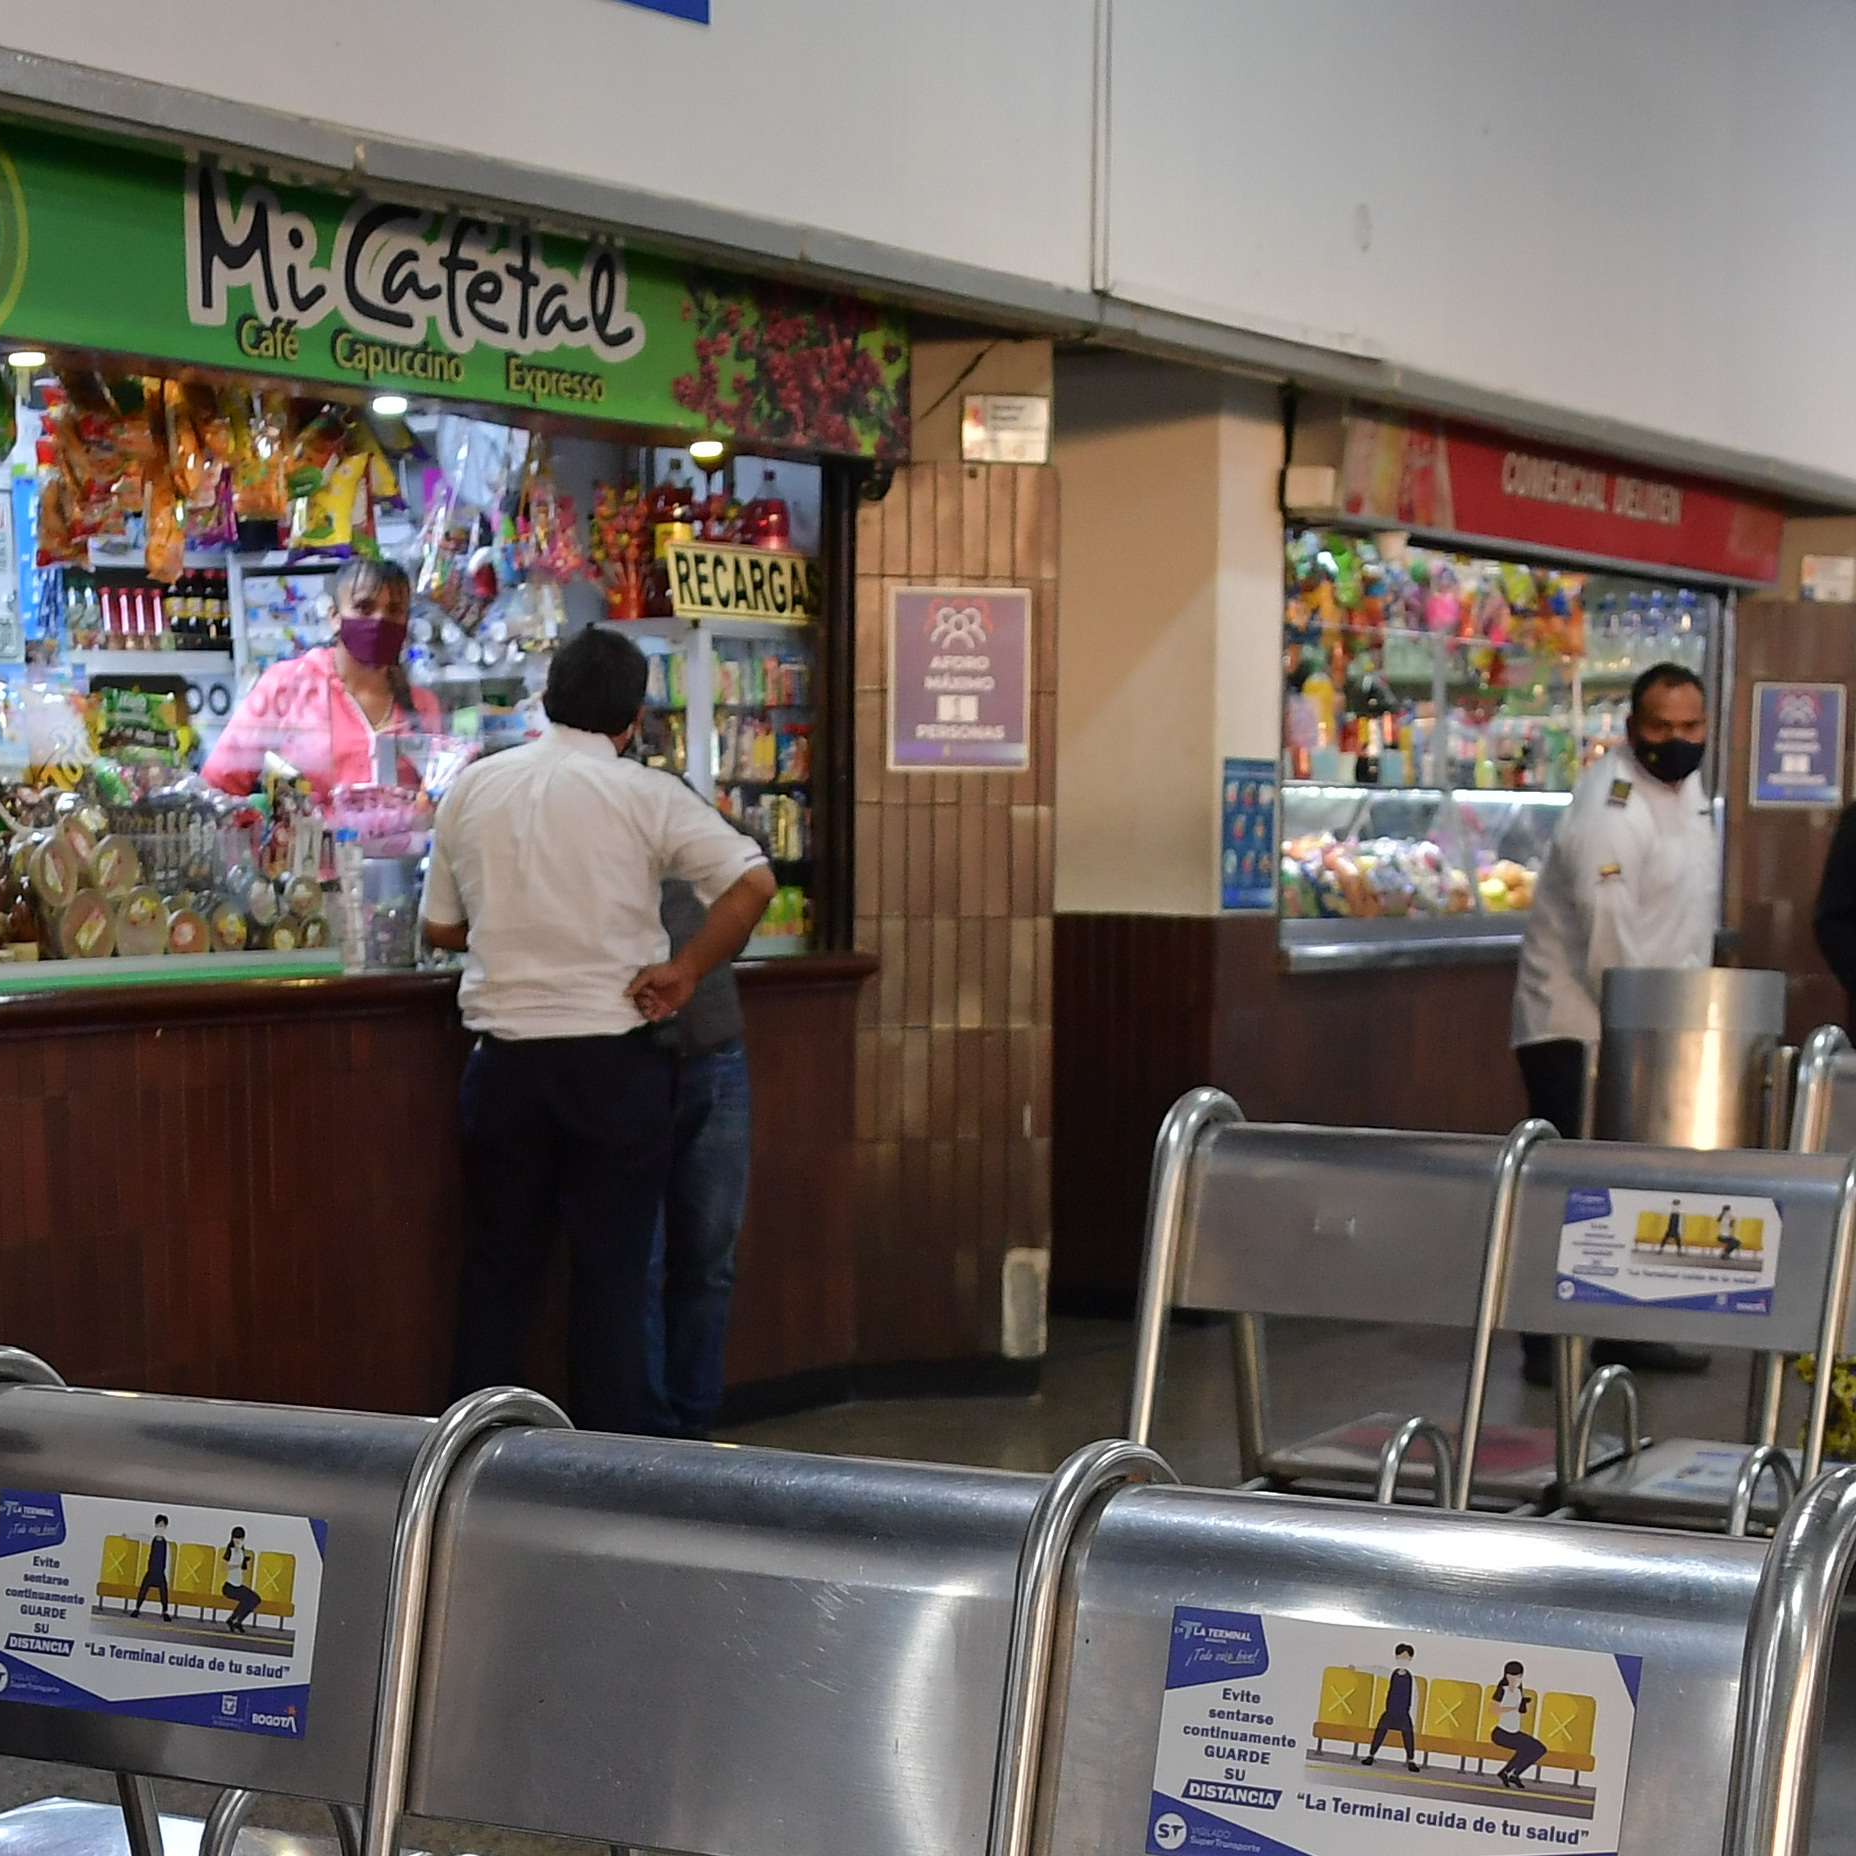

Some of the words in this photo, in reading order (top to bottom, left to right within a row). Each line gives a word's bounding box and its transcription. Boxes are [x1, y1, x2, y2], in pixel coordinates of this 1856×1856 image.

[195, 160, 328, 314] Mi
[342, 202, 636, 350] Cafetal
[238, 316, 300, 362] Café
[332, 326, 467, 384] Capuccino
[507, 354, 607, 403] Expresso
[32, 1555, 60, 1568] Evite
[23, 1573, 70, 1586] sentarse
[5, 1587, 85, 1606] continuamente
[20, 1603, 67, 1620] GUARDE
[33, 1622, 50, 1634] SU
[1208, 1628, 1253, 1643] TERMINAL
[8, 1636, 71, 1655] DISTANCIA
[109, 1644, 165, 1664] Terminal
[168, 1655, 204, 1670] cuida
[208, 1658, 225, 1672] de
[228, 1660, 243, 1674] tu
[1222, 1687, 1262, 1704] Evite
[1208, 1707, 1275, 1726] sentarse
[1182, 1724, 1297, 1749] continuamente
[1204, 1744, 1272, 1766] GUARDE
[1224, 1767, 1247, 1782] SU
[1188, 1782, 1276, 1807] DISTANCIA
[1296, 1792, 1327, 1812] “La
[1332, 1797, 1411, 1823] Terminal
[1415, 1811, 1467, 1831] cuida
[1472, 1816, 1497, 1835] de
[1501, 1819, 1521, 1838] tu
[1525, 1824, 1590, 1846] salud”
[1157, 1822, 1185, 1840] ST
[1190, 1834, 1262, 1854] SuperTransporte
